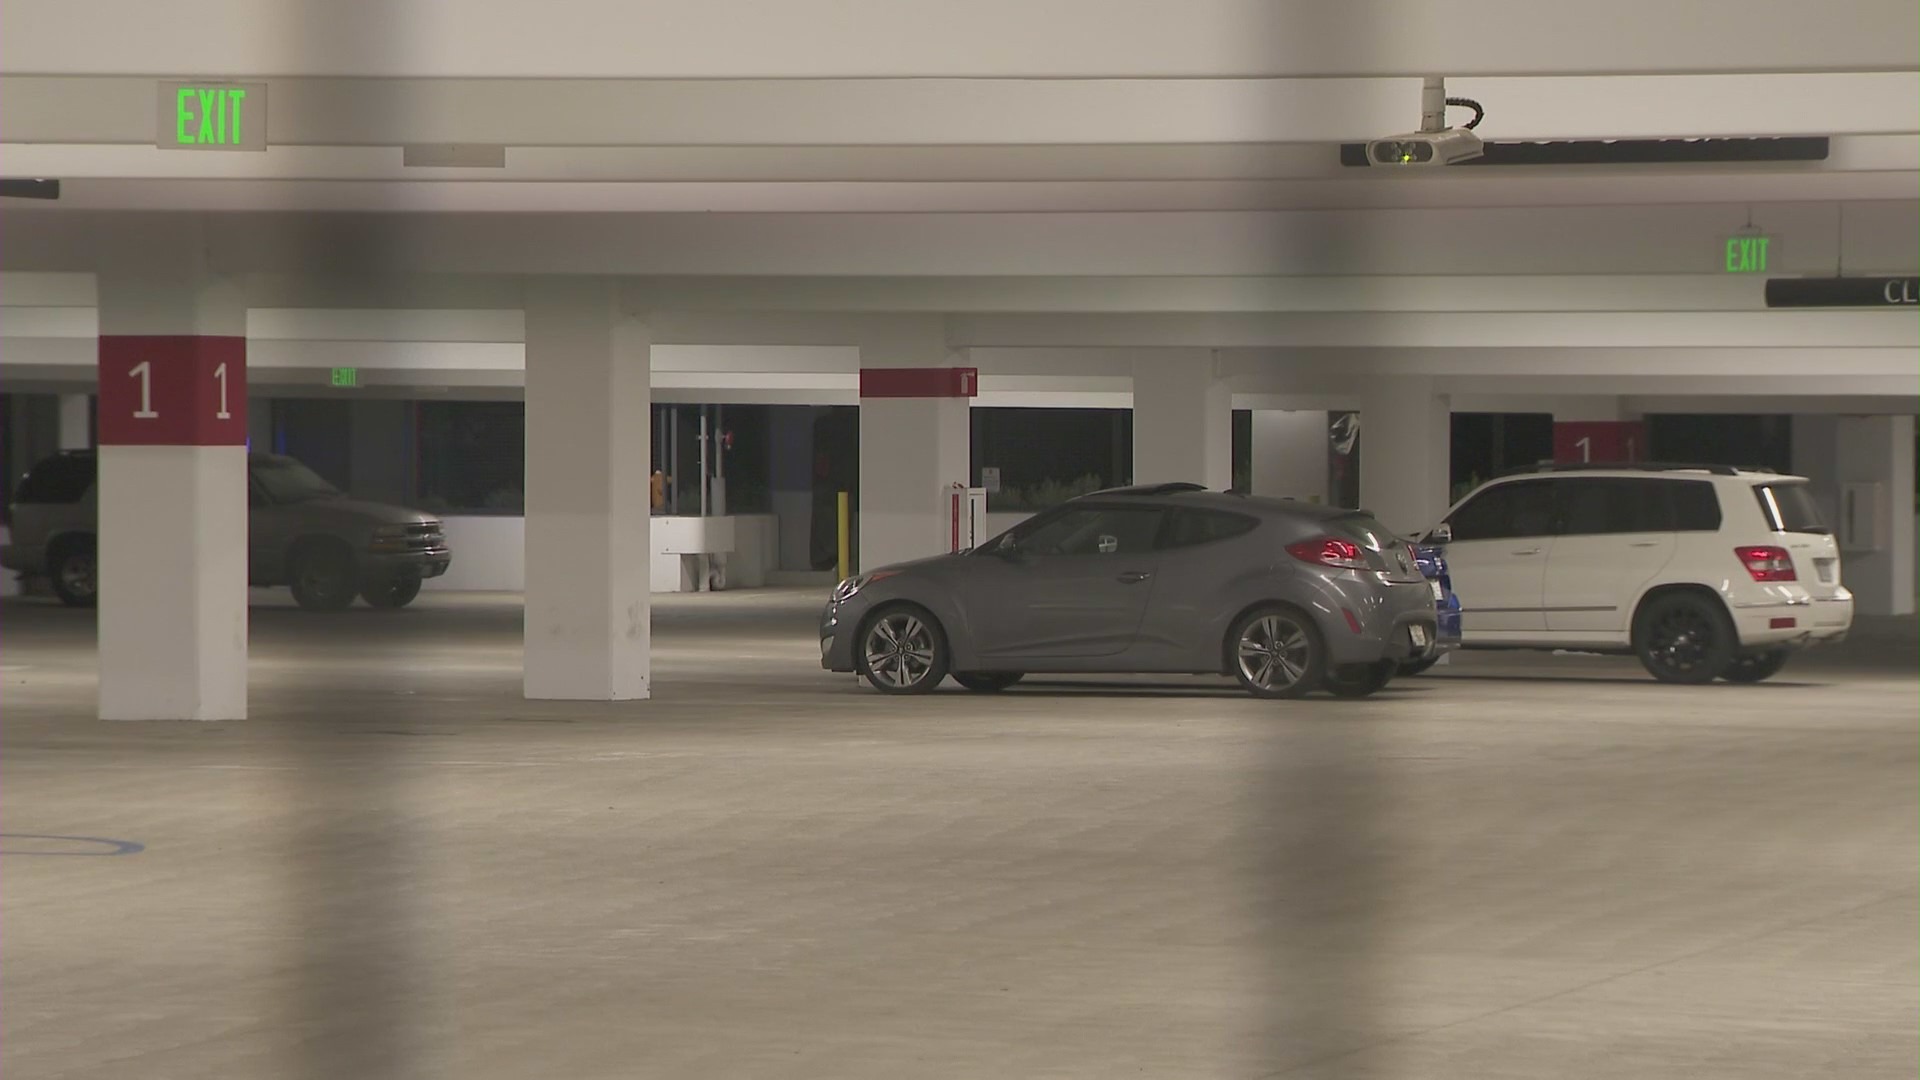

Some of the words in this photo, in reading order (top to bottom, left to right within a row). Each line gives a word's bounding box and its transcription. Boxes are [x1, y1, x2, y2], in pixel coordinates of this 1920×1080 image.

[176, 88, 246, 145] EXIT
[1726, 238, 1769, 272] EXIT
[128, 361, 159, 418] 1
[214, 362, 231, 419] 1
[332, 367, 356, 386] EXIT
[1575, 436, 1590, 463] 1
